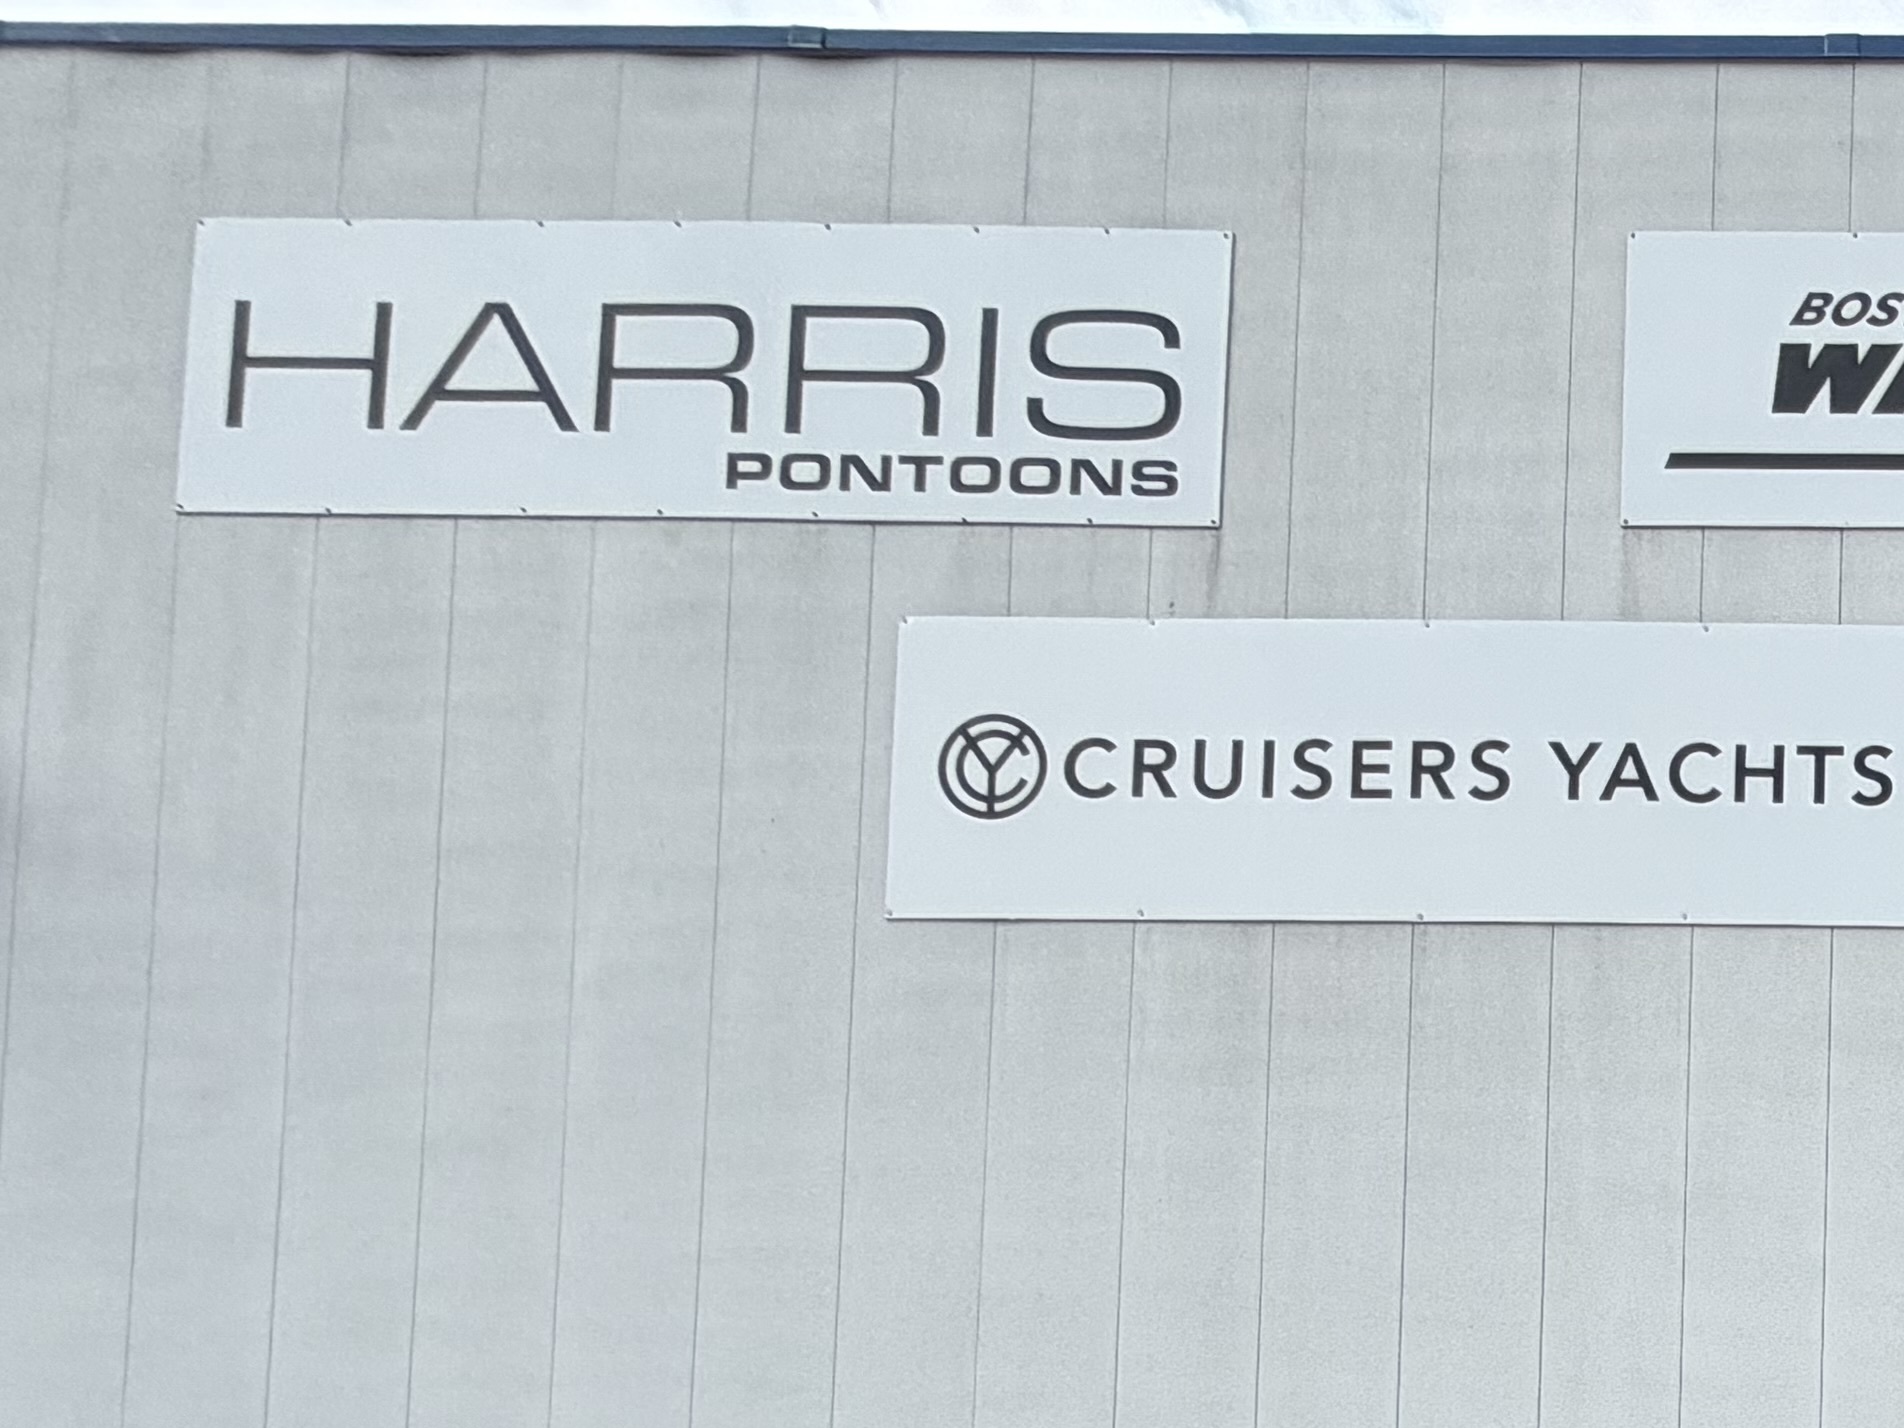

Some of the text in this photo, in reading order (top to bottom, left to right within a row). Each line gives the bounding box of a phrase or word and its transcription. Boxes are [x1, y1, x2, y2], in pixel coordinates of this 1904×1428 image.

[226, 300, 1182, 441] HARRIS
[724, 452, 1179, 497] PONTOONS
[1063, 737, 1894, 807] CRUISERS YACHTS
